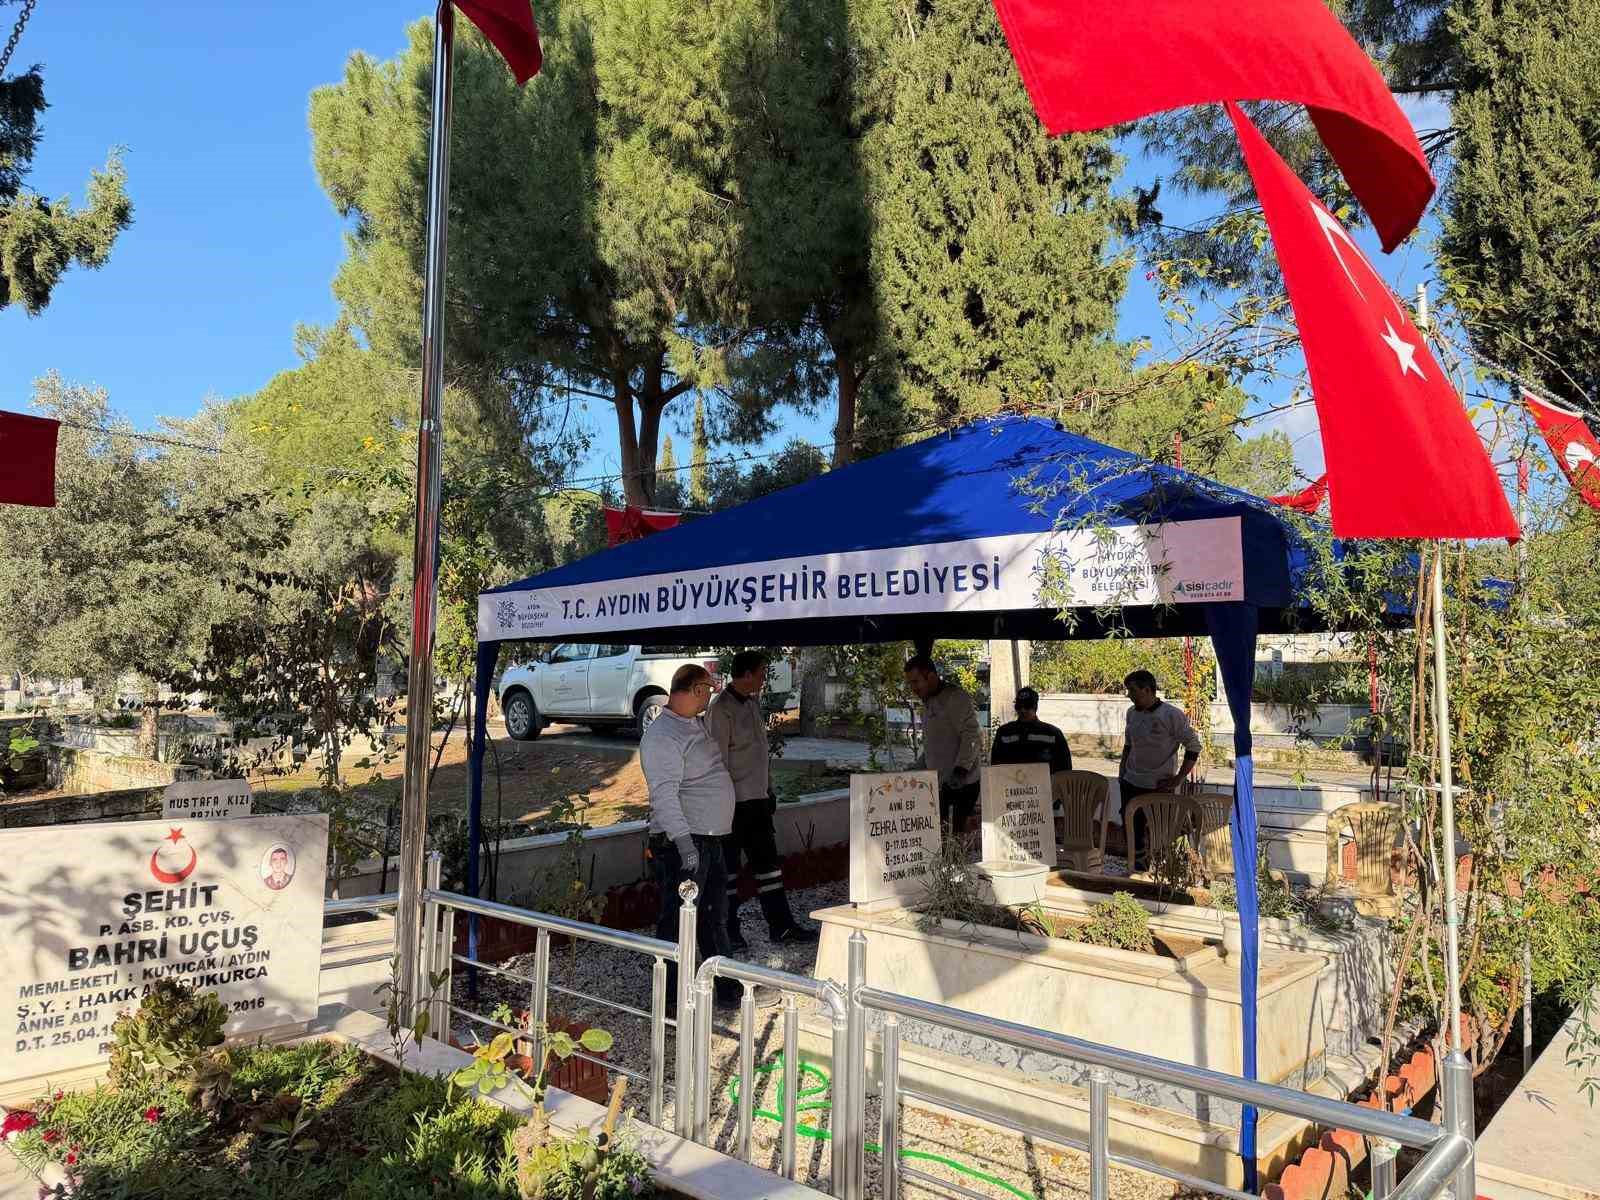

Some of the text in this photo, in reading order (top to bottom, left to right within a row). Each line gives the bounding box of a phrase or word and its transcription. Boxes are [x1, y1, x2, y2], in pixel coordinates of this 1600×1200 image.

[562, 555, 1002, 621] T.C. AYDIN BÜYÜKŞEHİR BELEDİYESİ
[169, 794, 249, 809] MUSTAFA KIZI
[869, 815, 935, 837] ZEHRA DEMİRAL
[122, 882, 220, 922] ŞEHİT
[99, 910, 236, 938] P. ASB. KD. ÇVŞ.
[68, 925, 259, 972] BAHRİ UÇUŞ
[19, 970, 118, 999] MEMLEKETİ
[142, 958, 217, 981] KUYUCAK
[228, 949, 271, 968] AYDIN
[16, 998, 56, 1021] Ş.Y.
[16, 1009, 99, 1035] ANNE ADI
[16, 1036, 46, 1053] D.T.
